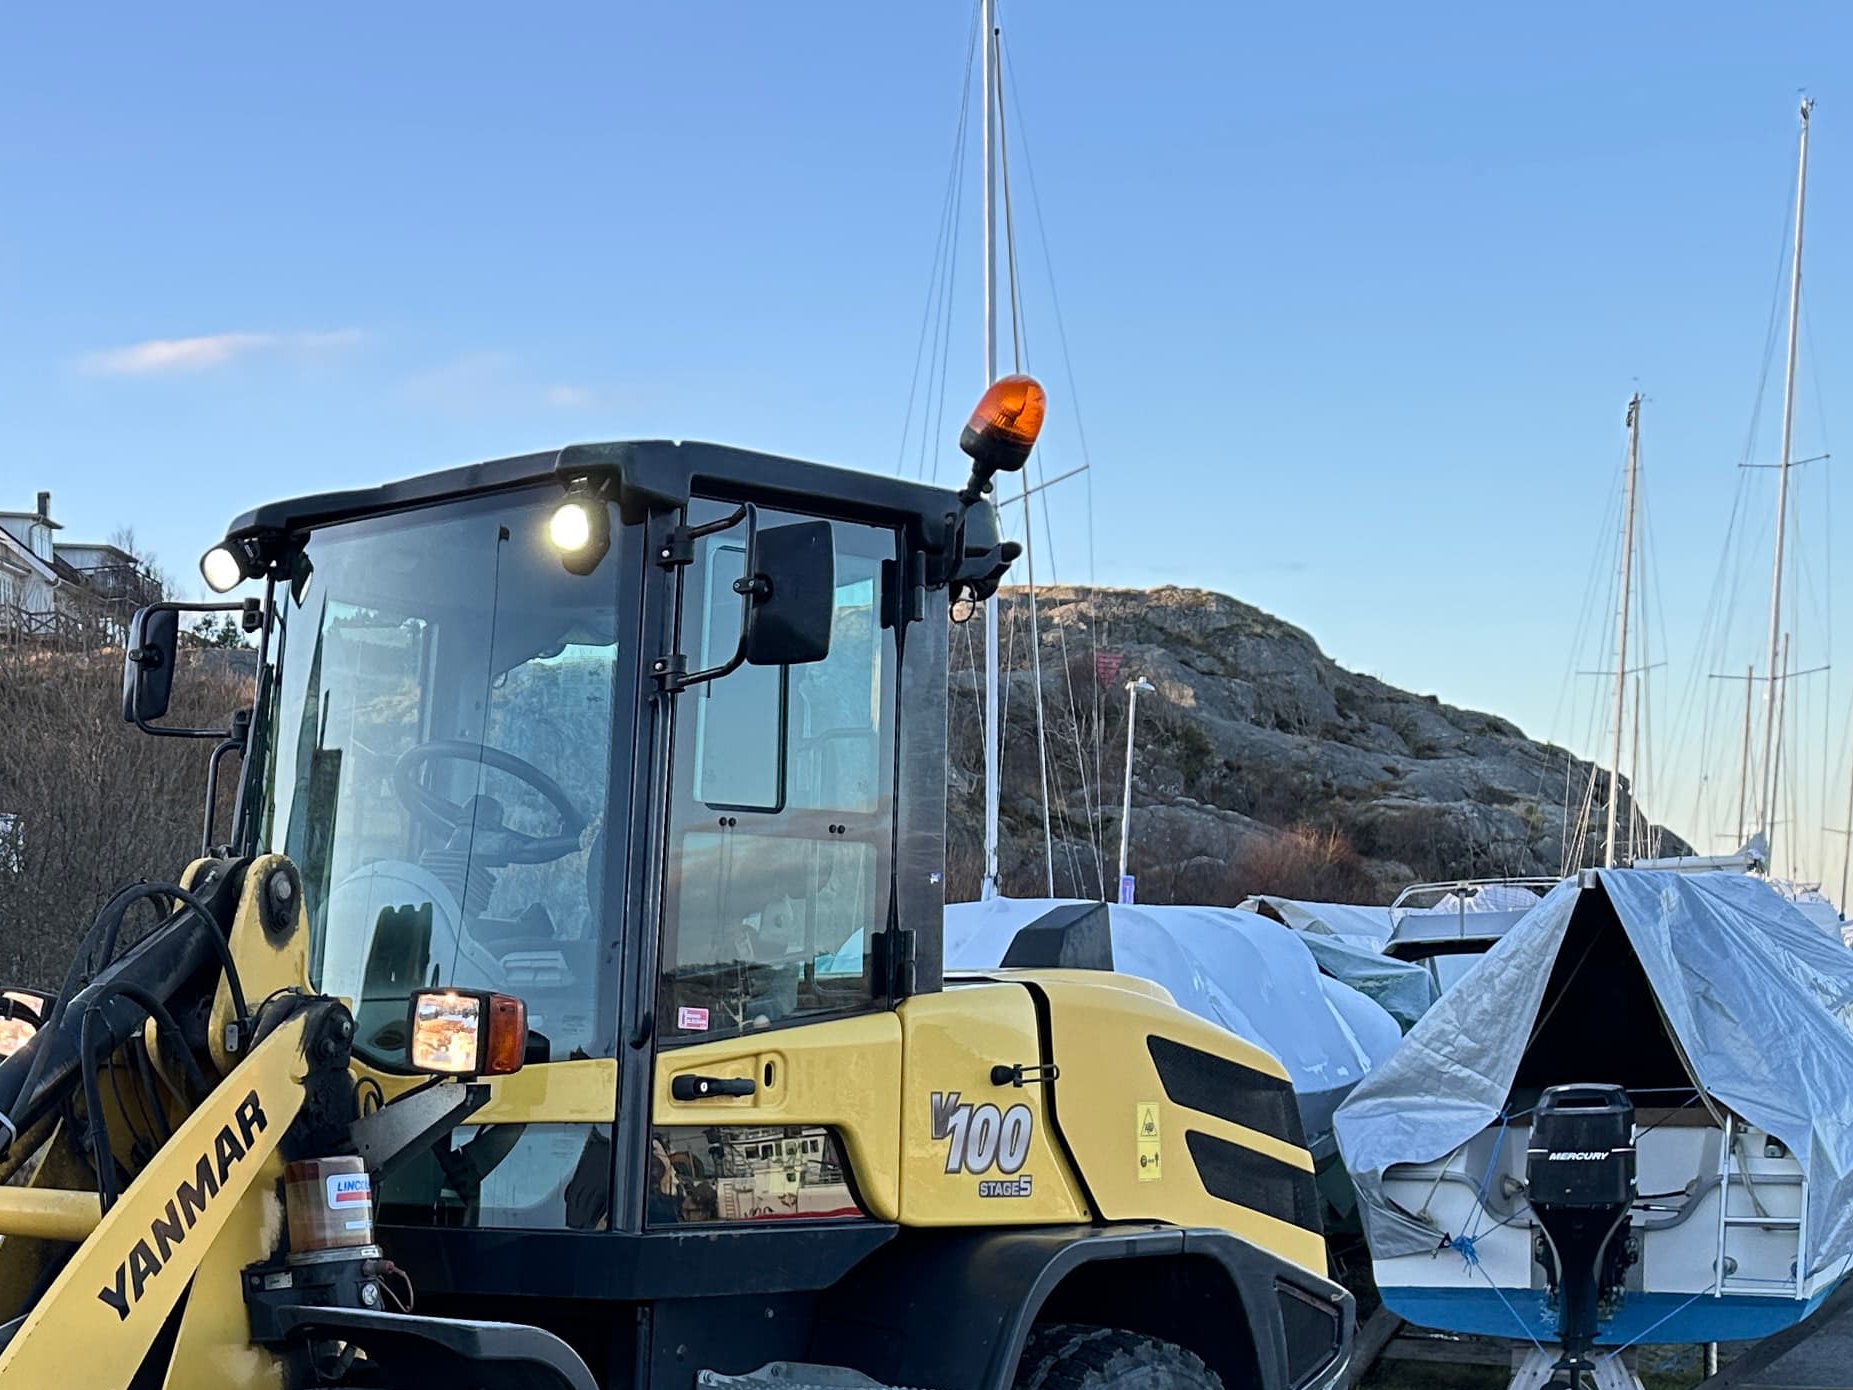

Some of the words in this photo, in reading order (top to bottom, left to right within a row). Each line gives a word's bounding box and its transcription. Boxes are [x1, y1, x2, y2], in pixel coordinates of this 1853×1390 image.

[930, 1091, 1033, 1174] V100
[1549, 1151, 1609, 1161] MERCURY
[98, 1089, 268, 1321] YANMAR
